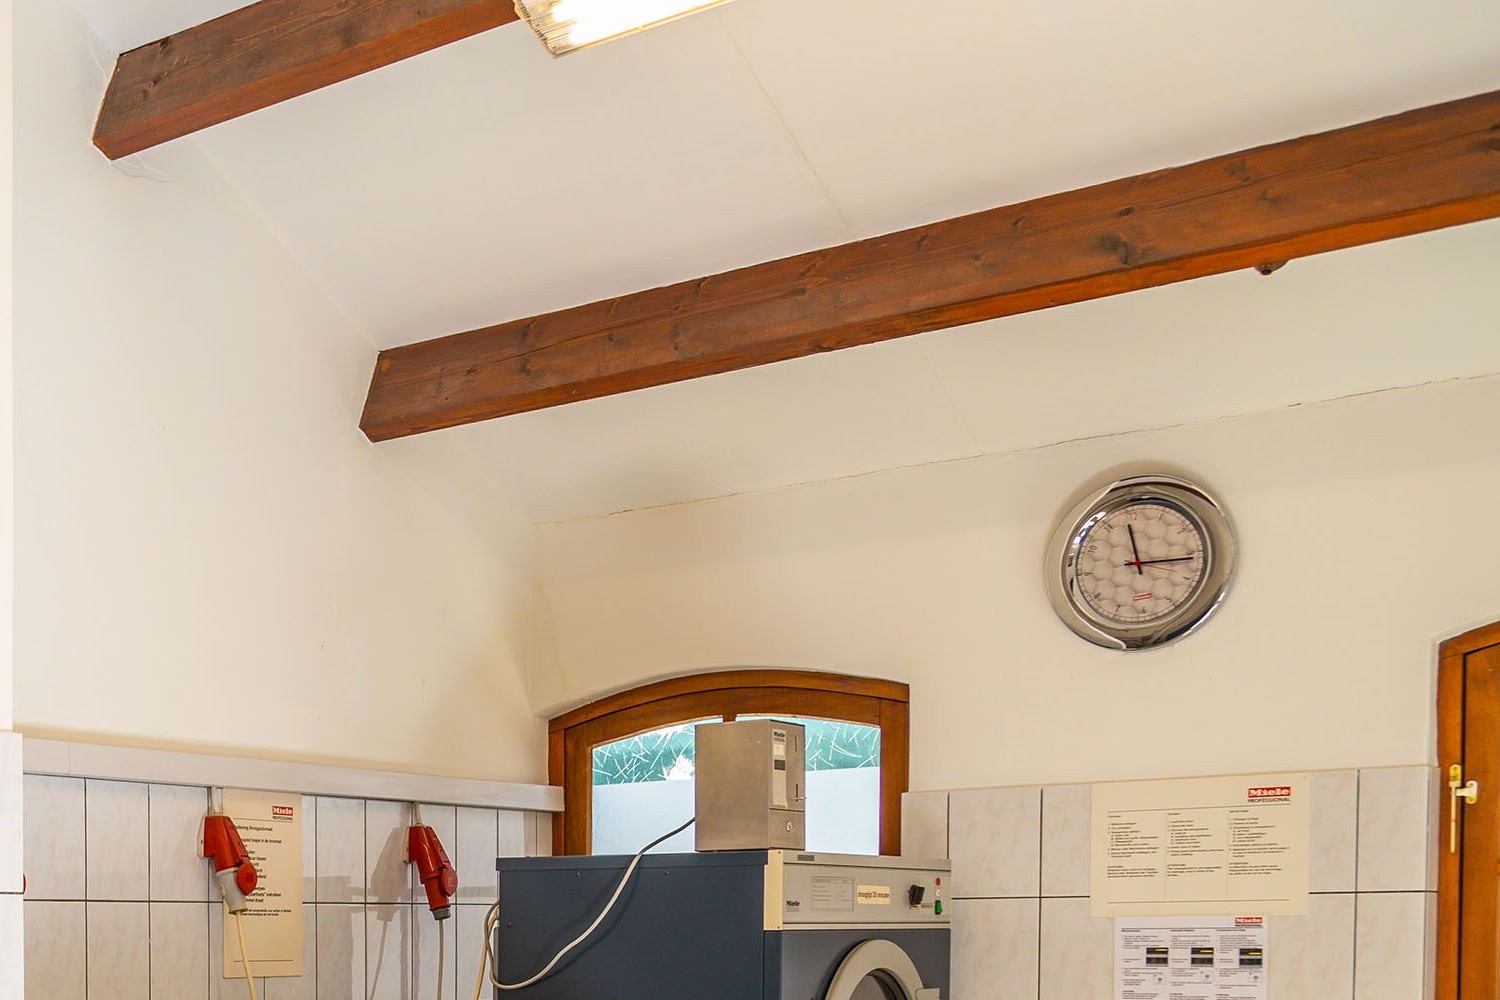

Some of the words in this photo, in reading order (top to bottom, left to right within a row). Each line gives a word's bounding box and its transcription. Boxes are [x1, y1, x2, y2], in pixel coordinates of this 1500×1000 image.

[1129, 511, 1138, 521] 12
[1087, 544, 1098, 554] 10
[1249, 787, 1289, 797] Miele
[272, 806, 293, 815] Miele
